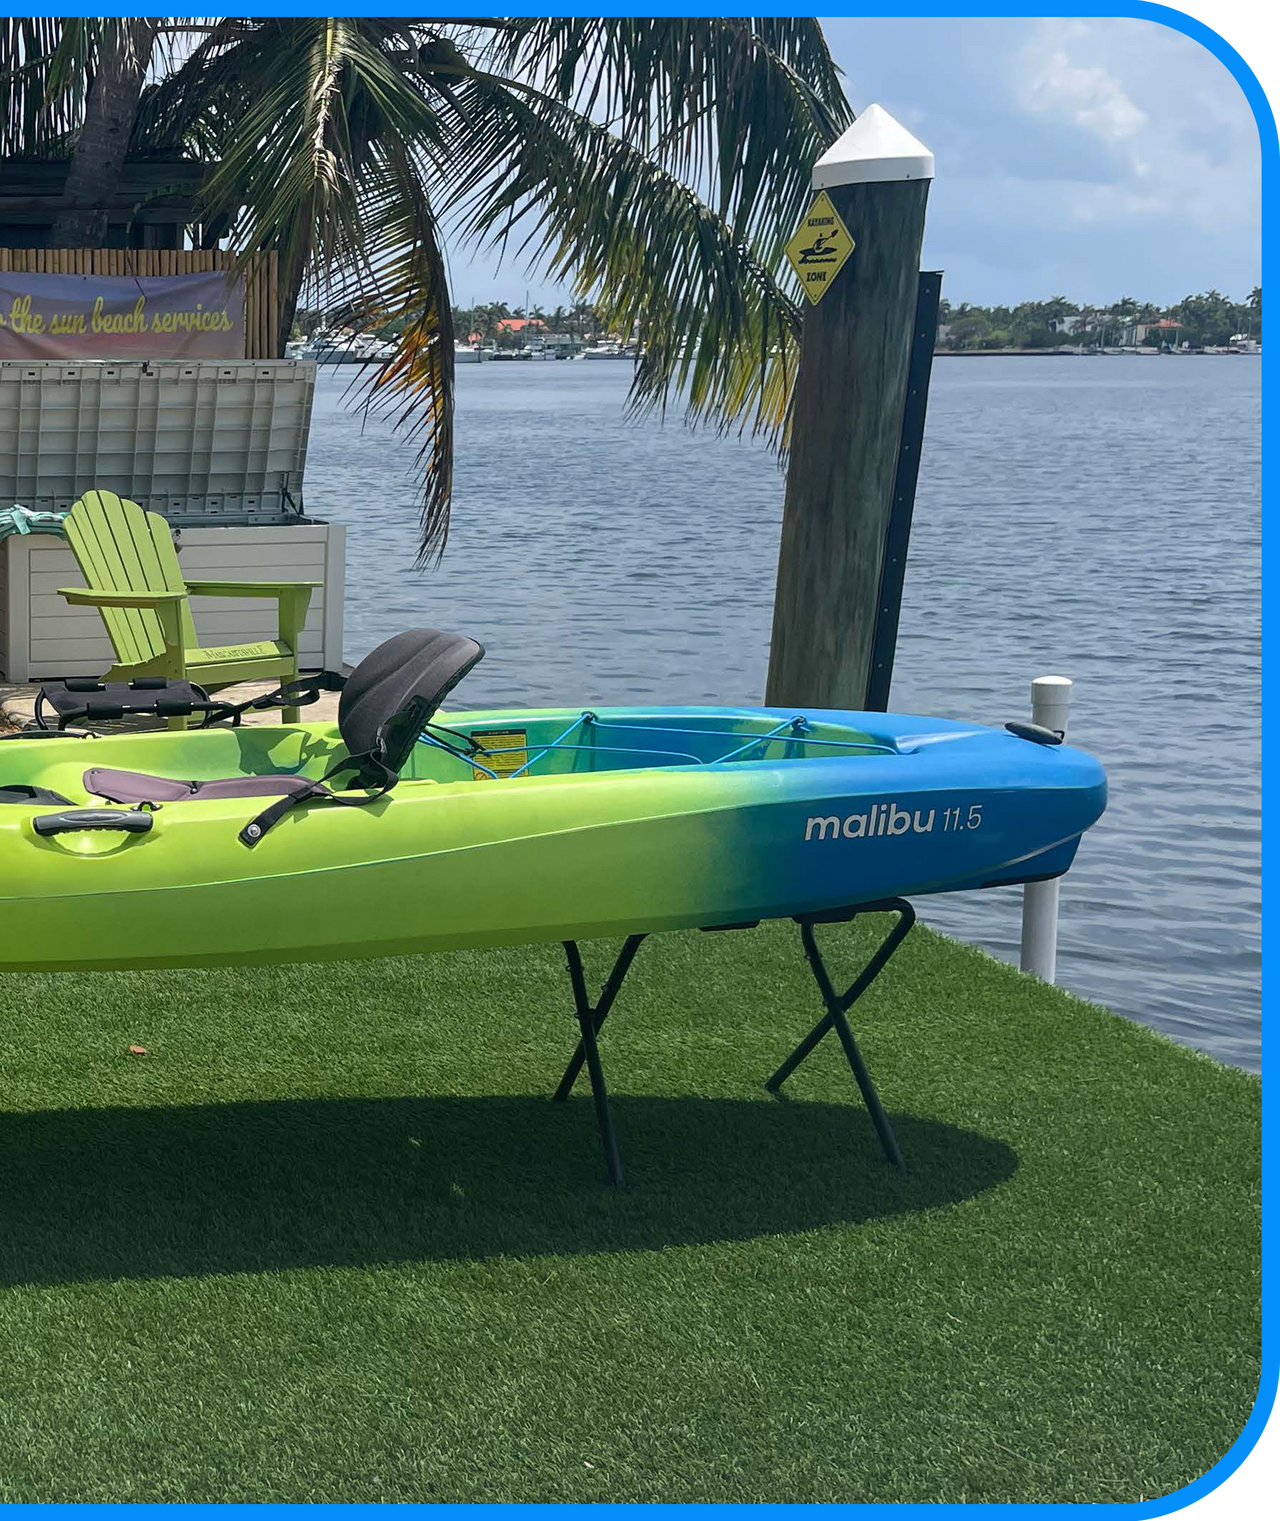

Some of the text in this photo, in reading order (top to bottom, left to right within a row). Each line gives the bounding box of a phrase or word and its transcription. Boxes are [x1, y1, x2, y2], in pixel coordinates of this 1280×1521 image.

[806, 271, 827, 282] ZONE
[8, 295, 47, 334] the
[48, 311, 87, 334] sun
[91, 295, 149, 334] beach
[151, 303, 235, 334] services
[804, 802, 983, 842] malibu 11.5
